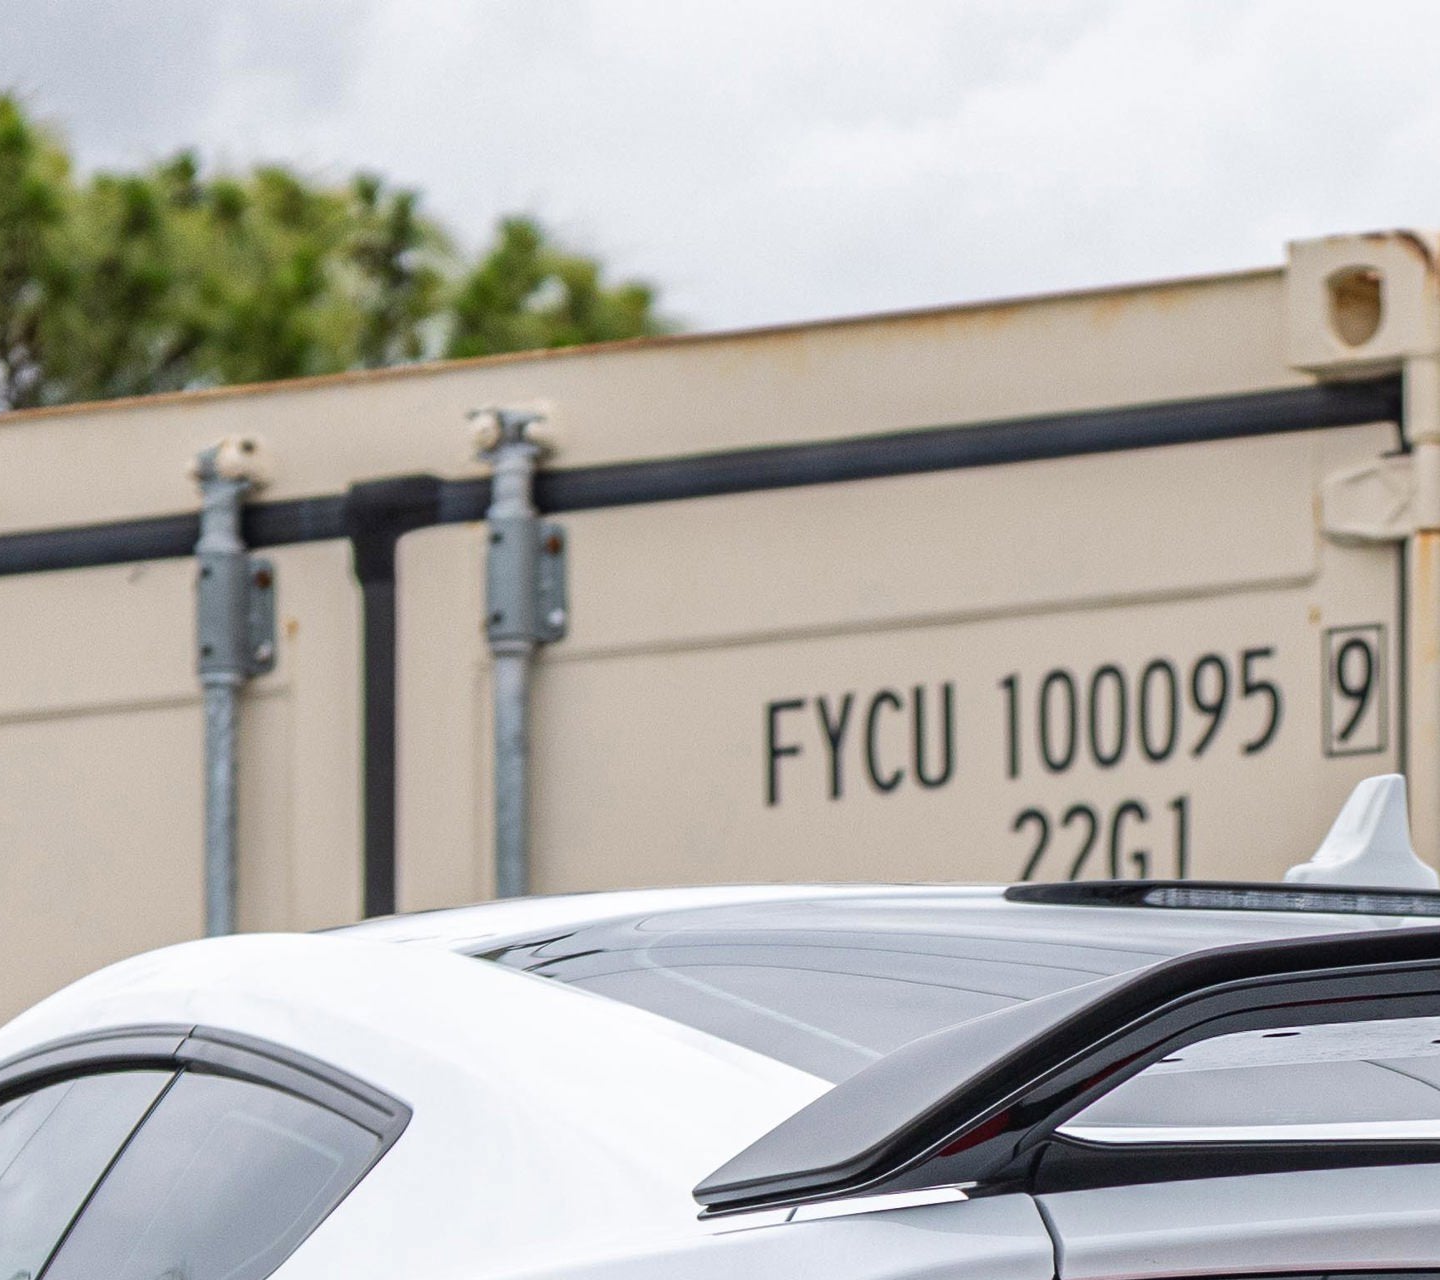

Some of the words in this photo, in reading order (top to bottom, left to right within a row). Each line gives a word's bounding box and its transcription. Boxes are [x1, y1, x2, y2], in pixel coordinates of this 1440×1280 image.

[766, 682, 955, 807] FYCU
[1000, 646, 1282, 780] 100095
[1334, 637, 1375, 743] 9
[1010, 796, 1189, 881] 22G1
